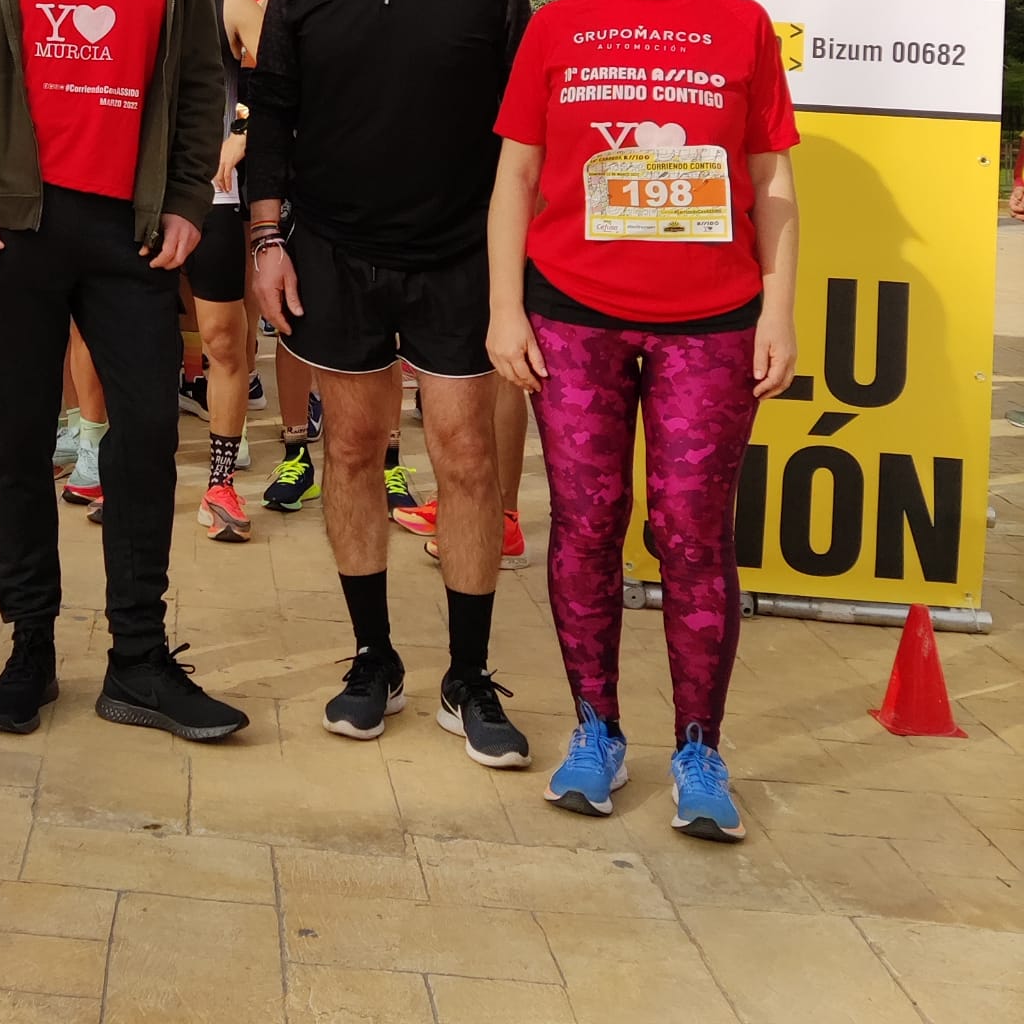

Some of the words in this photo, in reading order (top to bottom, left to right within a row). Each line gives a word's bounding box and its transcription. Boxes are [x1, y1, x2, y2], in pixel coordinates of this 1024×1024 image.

[35, 3, 77, 43] Y
[34, 42, 113, 61] MURCIA
[596, 43, 687, 53] AUTOMOCIÓN
[812, 37, 883, 62] Bizum
[892, 41, 966, 66] 00682
[582, 67, 647, 82] CARRERA
[651, 68, 726, 88] ASSIDO
[560, 84, 647, 104] CORRIENDO
[652, 85, 724, 109] CONTIGO
[690, 162, 722, 170] CONTIGO
[622, 180, 694, 207] 198
[215, 455, 233, 466] RUN
